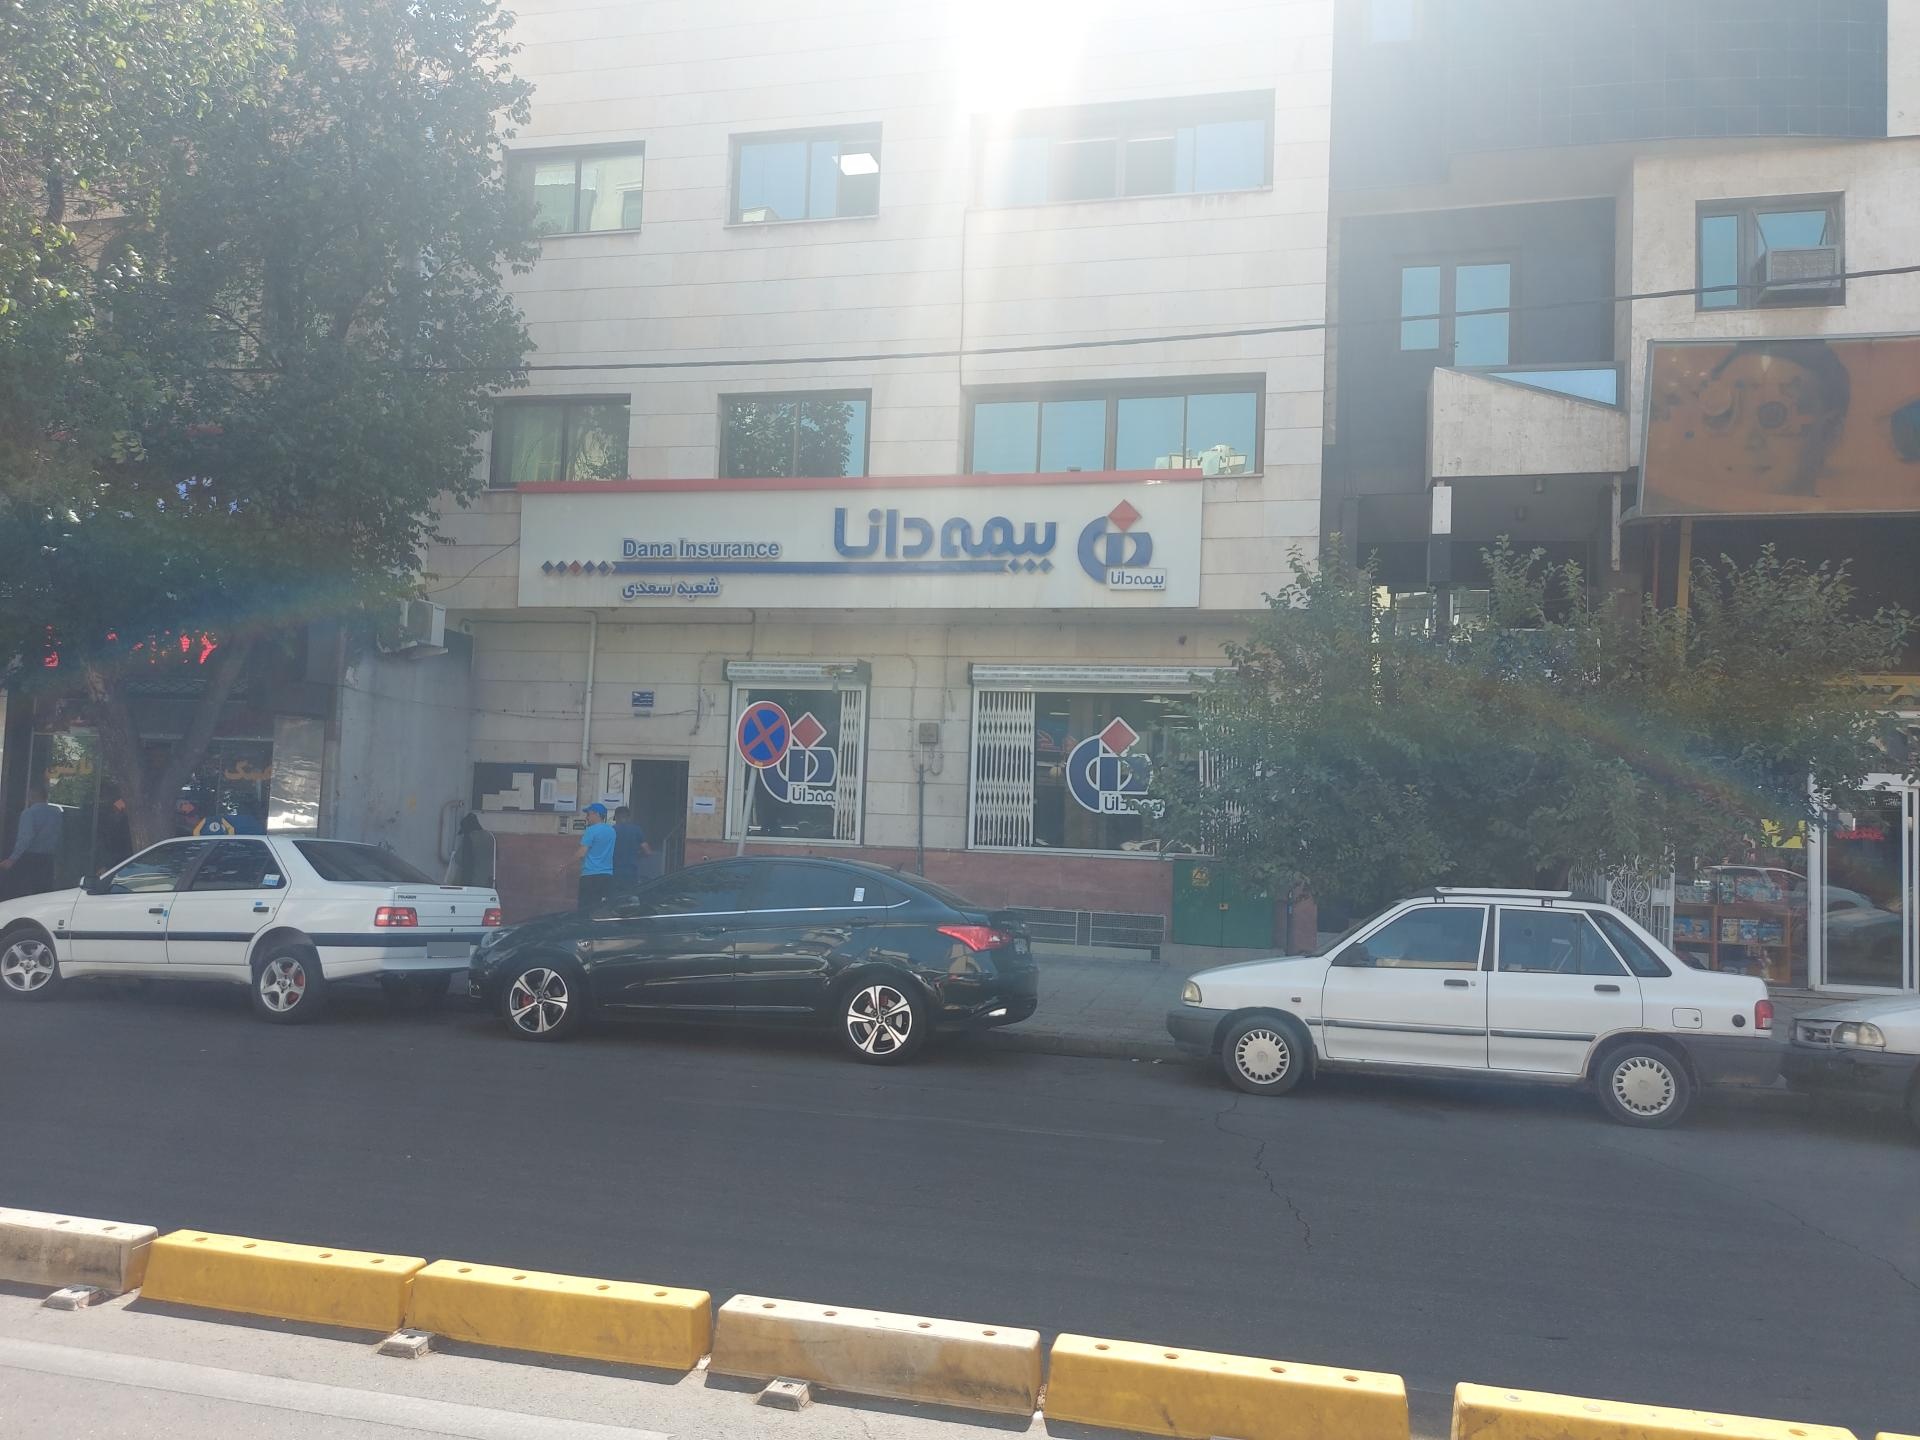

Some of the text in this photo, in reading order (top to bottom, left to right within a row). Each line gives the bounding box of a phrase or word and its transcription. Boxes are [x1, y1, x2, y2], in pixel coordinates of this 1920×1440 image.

[623, 539, 780, 557] Dana Insurance
[834, 507, 1057, 574] بیمه دانا
[622, 578, 719, 599] شعبه سعدی
[1111, 571, 1164, 588] بیمه دانا
